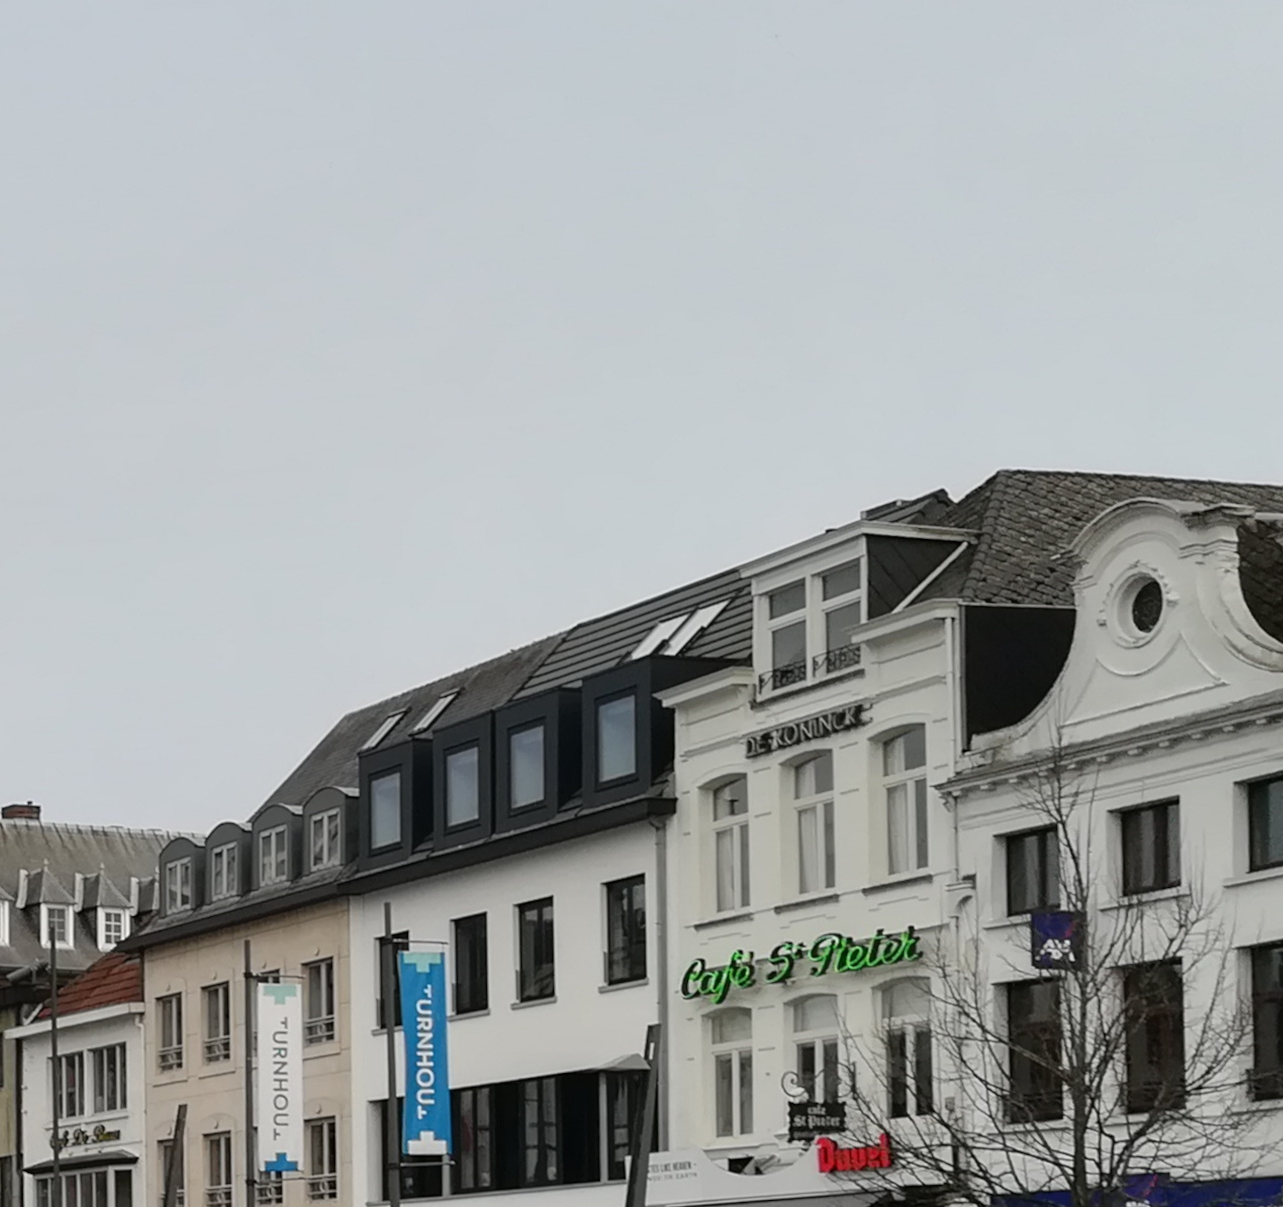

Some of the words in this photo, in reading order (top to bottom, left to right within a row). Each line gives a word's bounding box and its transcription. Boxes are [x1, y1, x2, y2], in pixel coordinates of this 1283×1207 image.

[768, 703, 864, 752] KONINCK
[680, 949, 756, 1004] Café
[806, 925, 924, 977] Pieter
[816, 1133, 892, 1173] Duvel
